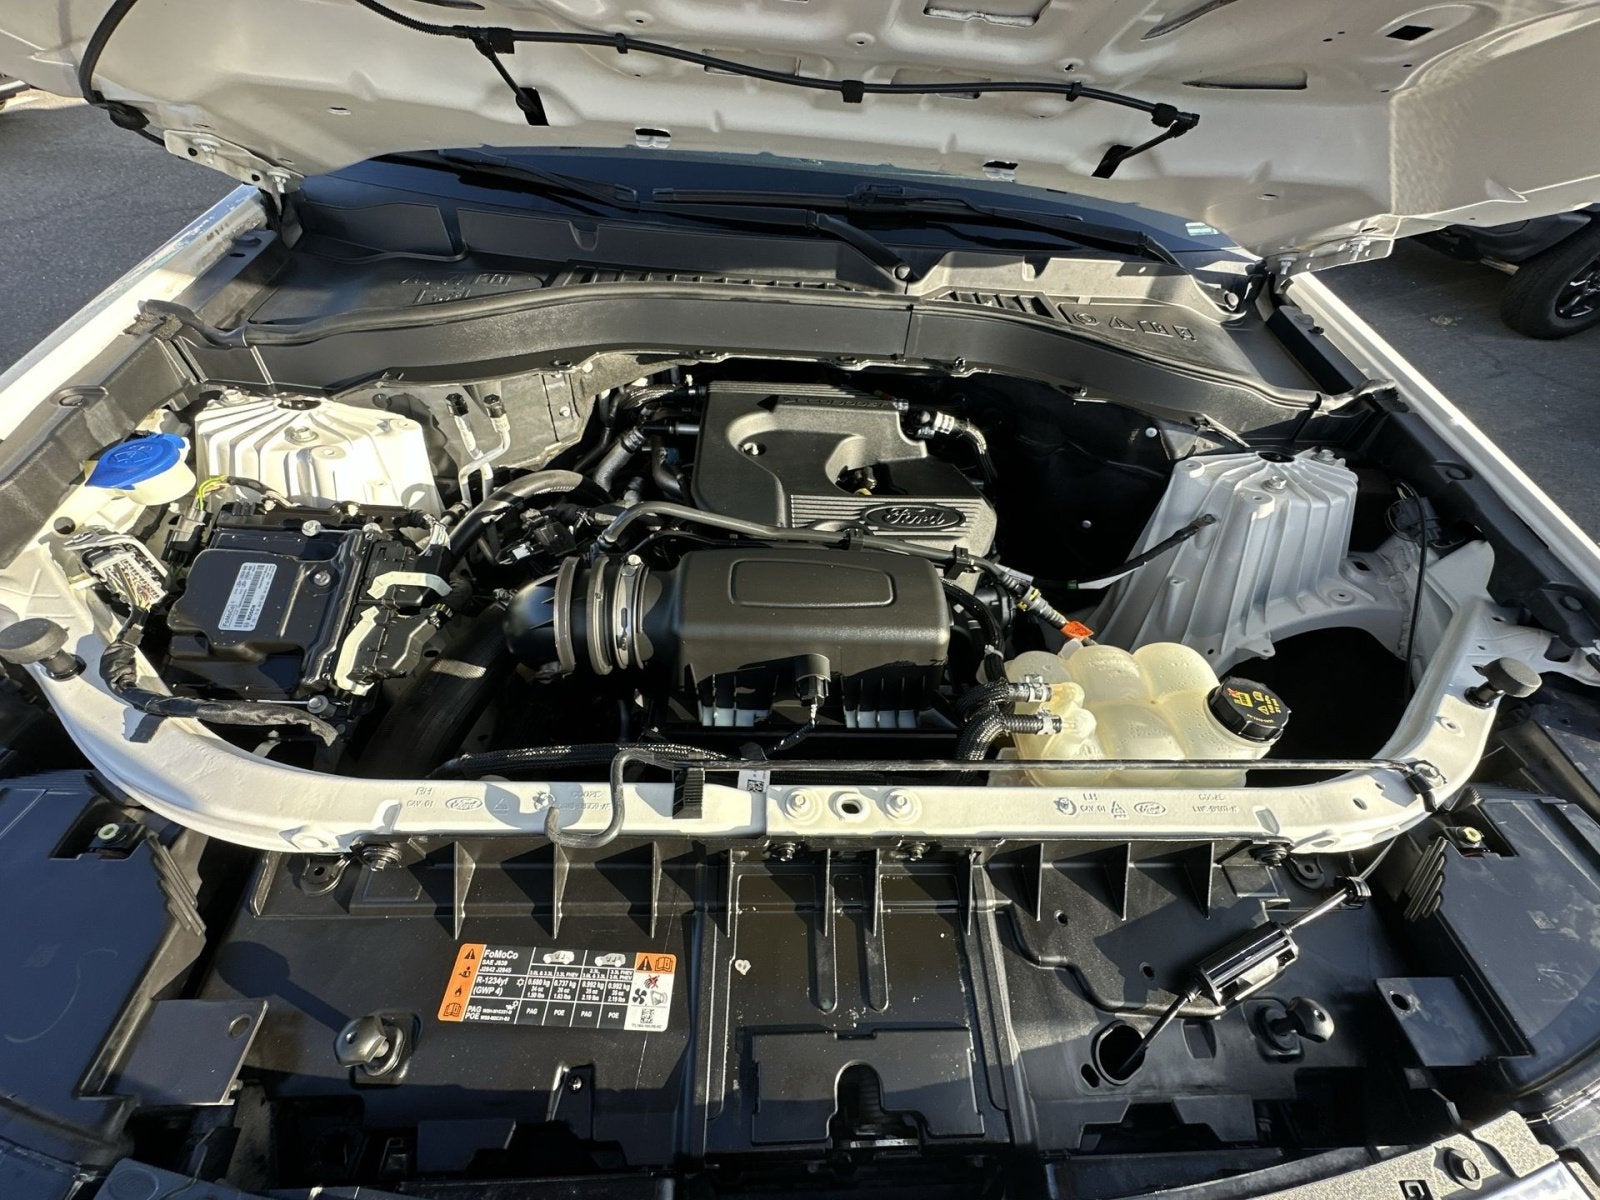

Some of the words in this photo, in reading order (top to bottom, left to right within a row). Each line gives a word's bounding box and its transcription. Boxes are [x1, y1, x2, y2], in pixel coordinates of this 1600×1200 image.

[884, 507, 945, 525] Ford
[246, 604, 256, 621] BOSCH
[415, 786, 433, 796] RH
[483, 949, 519, 960] FoMoCo
[476, 976, 509, 986] R-1234yf
[543, 979, 550, 988] kg
[553, 979, 569, 987] 0.737
[569, 980, 577, 989] kg
[597, 981, 604, 990] kg
[473, 986, 495, 995] (GWP
[495, 987, 503, 996] 4)
[623, 983, 630, 992] kg
[467, 1005, 482, 1013] PAG
[526, 1007, 538, 1015] PAG
[465, 1012, 480, 1020] POE
[581, 1010, 593, 1018] PAG
[608, 1011, 619, 1019] POE
